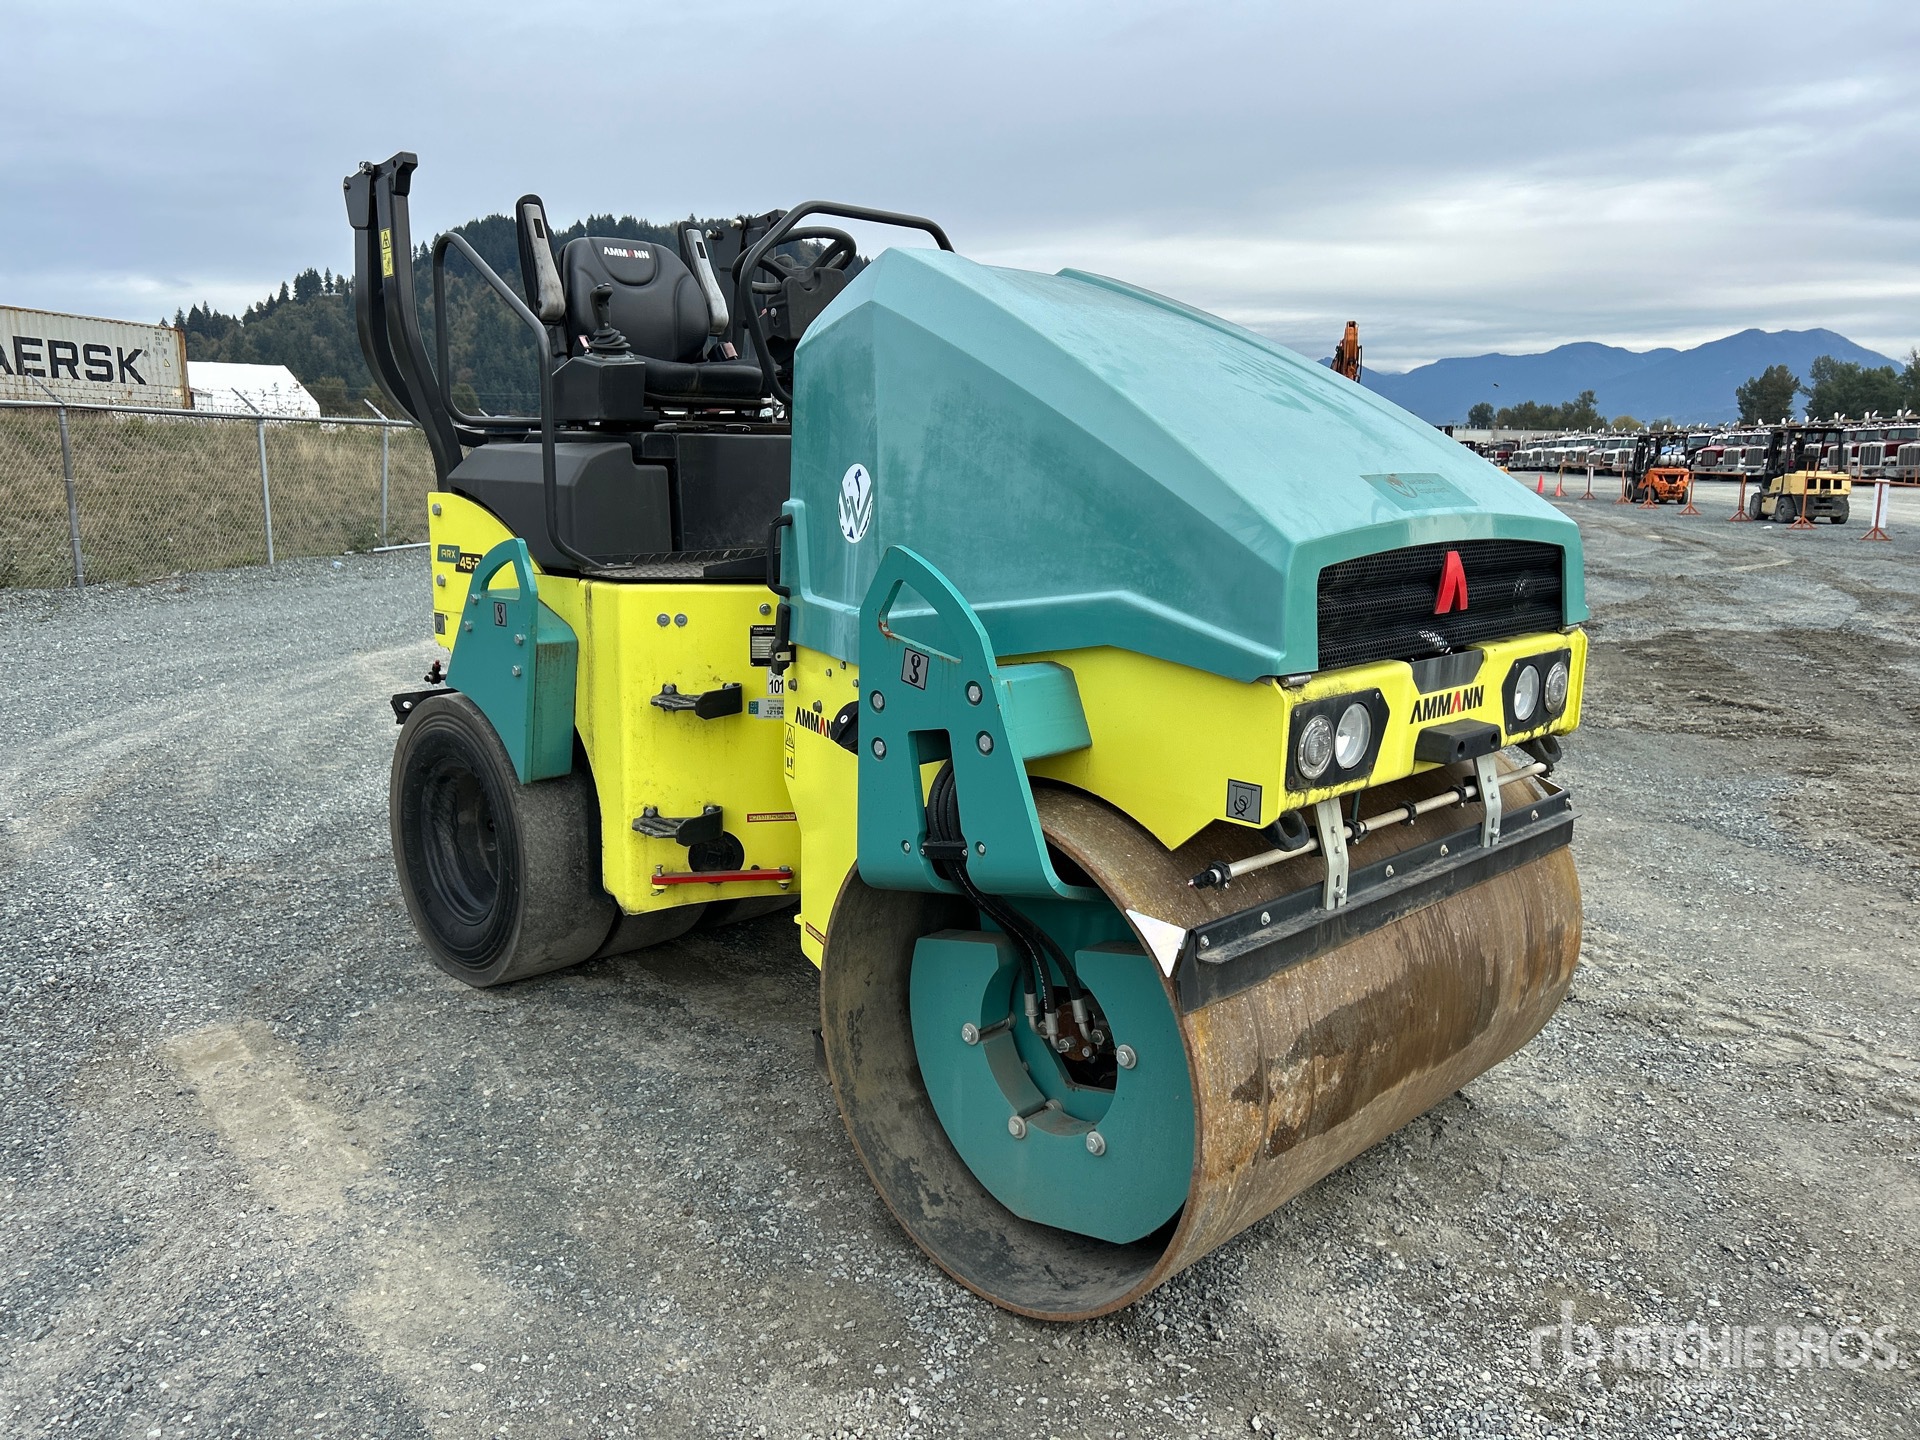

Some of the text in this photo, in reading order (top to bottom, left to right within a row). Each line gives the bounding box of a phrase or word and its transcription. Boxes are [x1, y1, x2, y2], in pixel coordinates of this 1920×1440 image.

[603, 246, 650, 259] AMMANN
[441, 549, 456, 559] ARX
[1409, 685, 1485, 724] AMMANN
[795, 706, 836, 739] AMMAN
